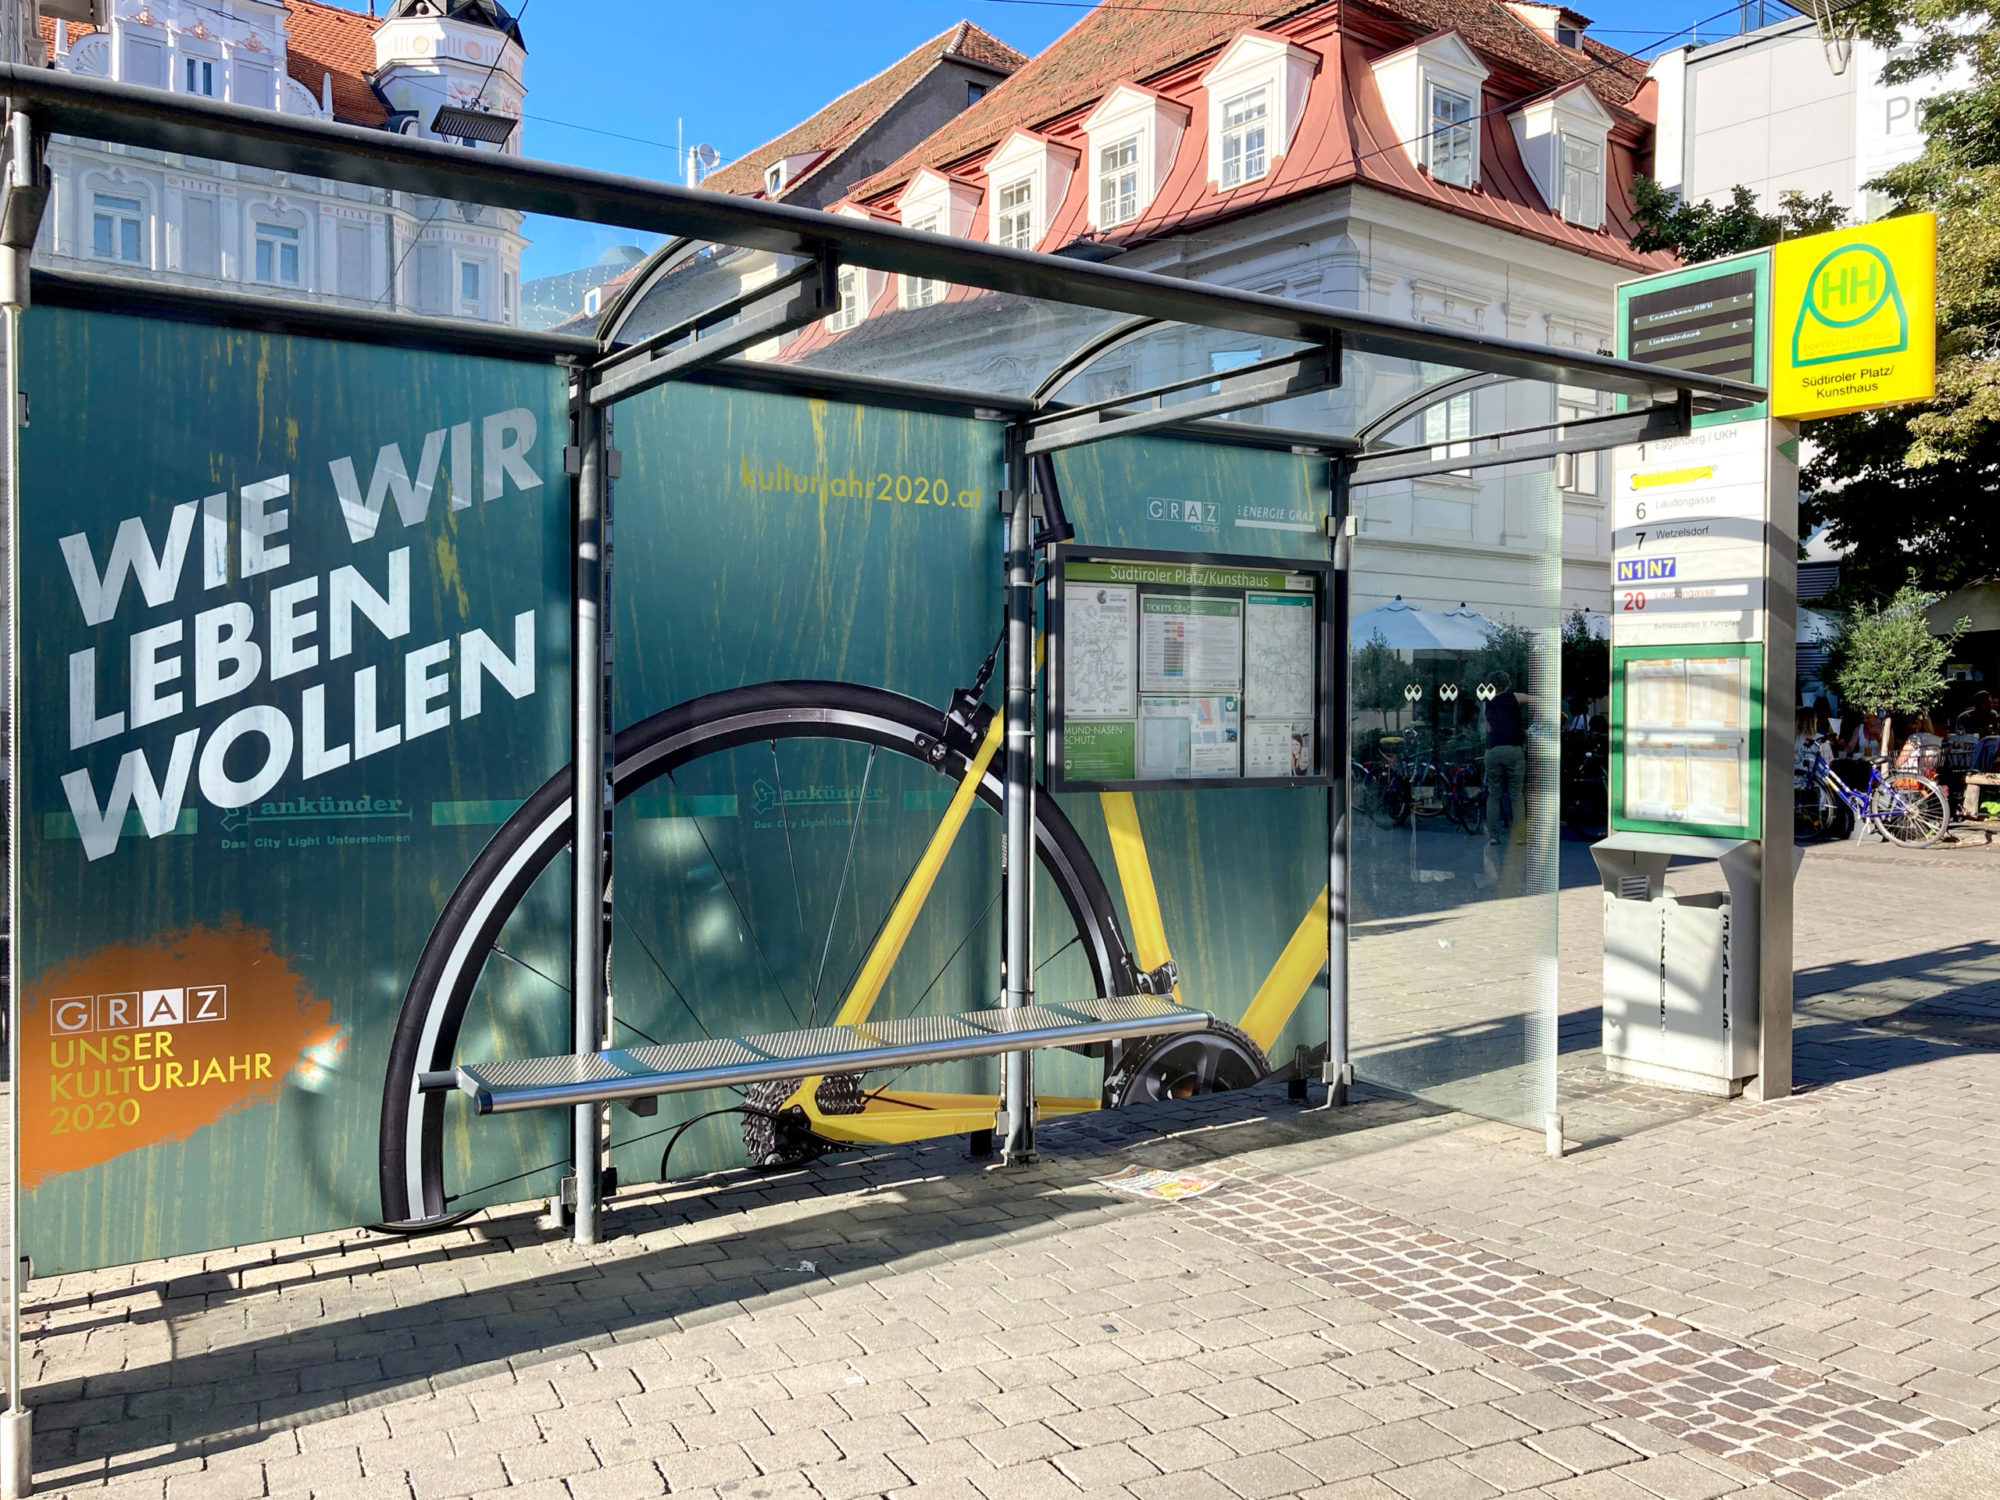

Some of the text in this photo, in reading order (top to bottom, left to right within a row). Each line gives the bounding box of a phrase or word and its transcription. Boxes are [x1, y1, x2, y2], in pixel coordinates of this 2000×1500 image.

[1822, 262, 1877, 309] HH
[1801, 364, 1895, 389] Südtiroler Platz/
[1816, 382, 1879, 399] Kunsthaus
[1637, 443, 1646, 462] 1
[1655, 434, 1706, 451] Eggenberg
[1714, 428, 1738, 441] UKH
[741, 456, 982, 509] kulturjahr2020.at
[58, 406, 544, 627] WIE WIR
[1148, 499, 1218, 524] GRAZ
[1242, 505, 1314, 522] ENERGIE GRAZ
[1636, 495, 1716, 520] 6 Laudongasse
[1635, 525, 1710, 550] 7 Wetzelsdorf
[1110, 565, 1172, 582] Südtiroler
[1175, 568, 1269, 588] Platz/Kunsthaus
[1620, 559, 1674, 579] N1 N7
[1623, 591, 1646, 611] 20
[69, 546, 410, 751] LEBEN
[60, 609, 536, 862] WOLLEN
[1064, 736, 1096, 745] SCHUTZ
[261, 795, 403, 815] ankünder
[778, 818, 797, 829] Cy
[221, 833, 411, 849] Das City Light Unternehmen
[54, 987, 222, 1033] GRAZ
[50, 1031, 174, 1069] UNSER
[50, 1053, 272, 1101] KULTURJAHR
[50, 1099, 140, 1135] 2020
